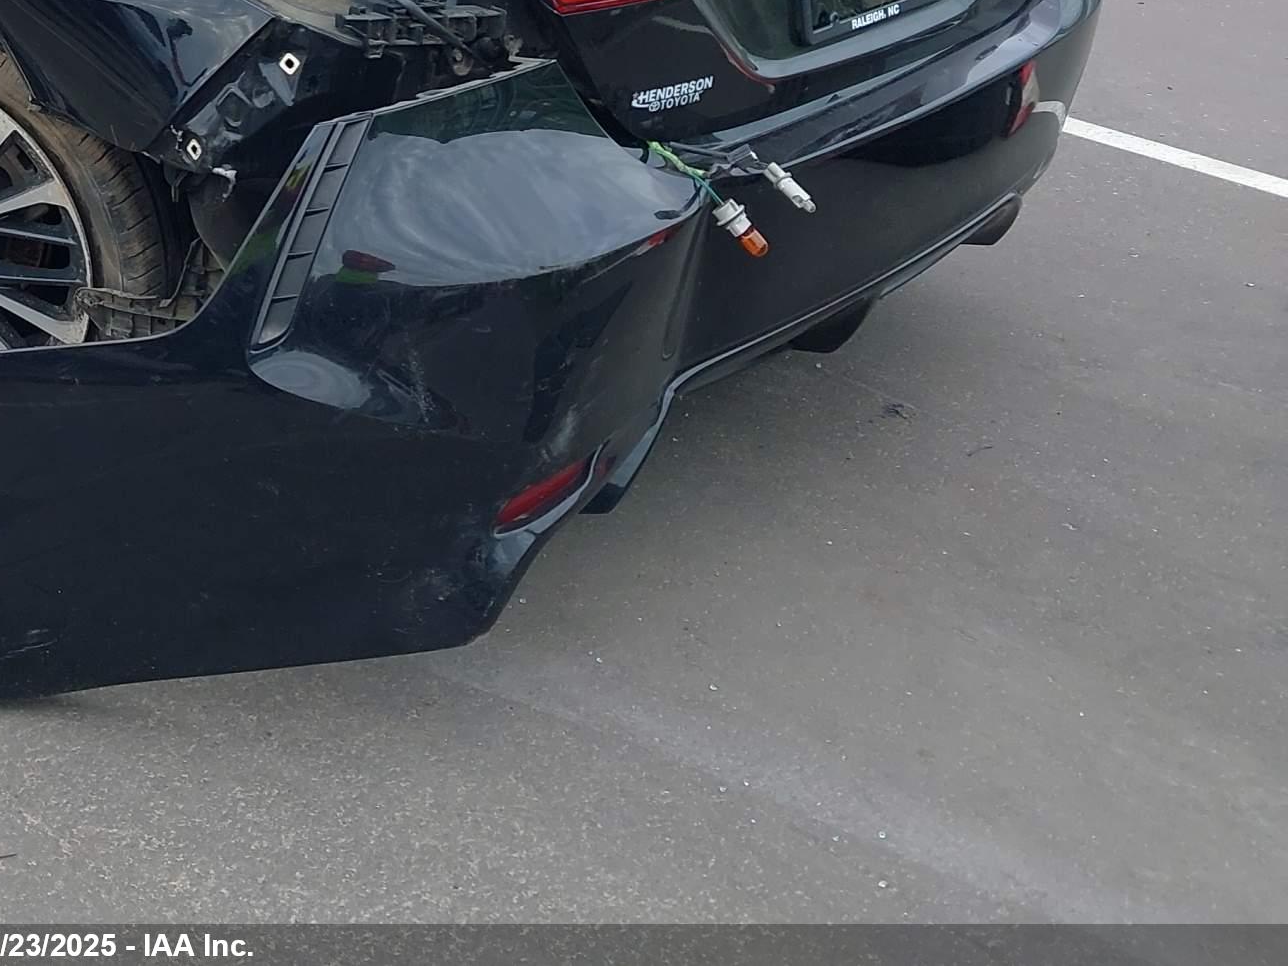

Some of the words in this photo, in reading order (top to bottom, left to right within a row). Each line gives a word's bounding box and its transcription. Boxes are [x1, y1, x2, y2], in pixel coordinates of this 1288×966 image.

[887, 4, 900, 17] NC
[638, 76, 714, 104] HENDERSON
[660, 92, 701, 111] TOYOTA
